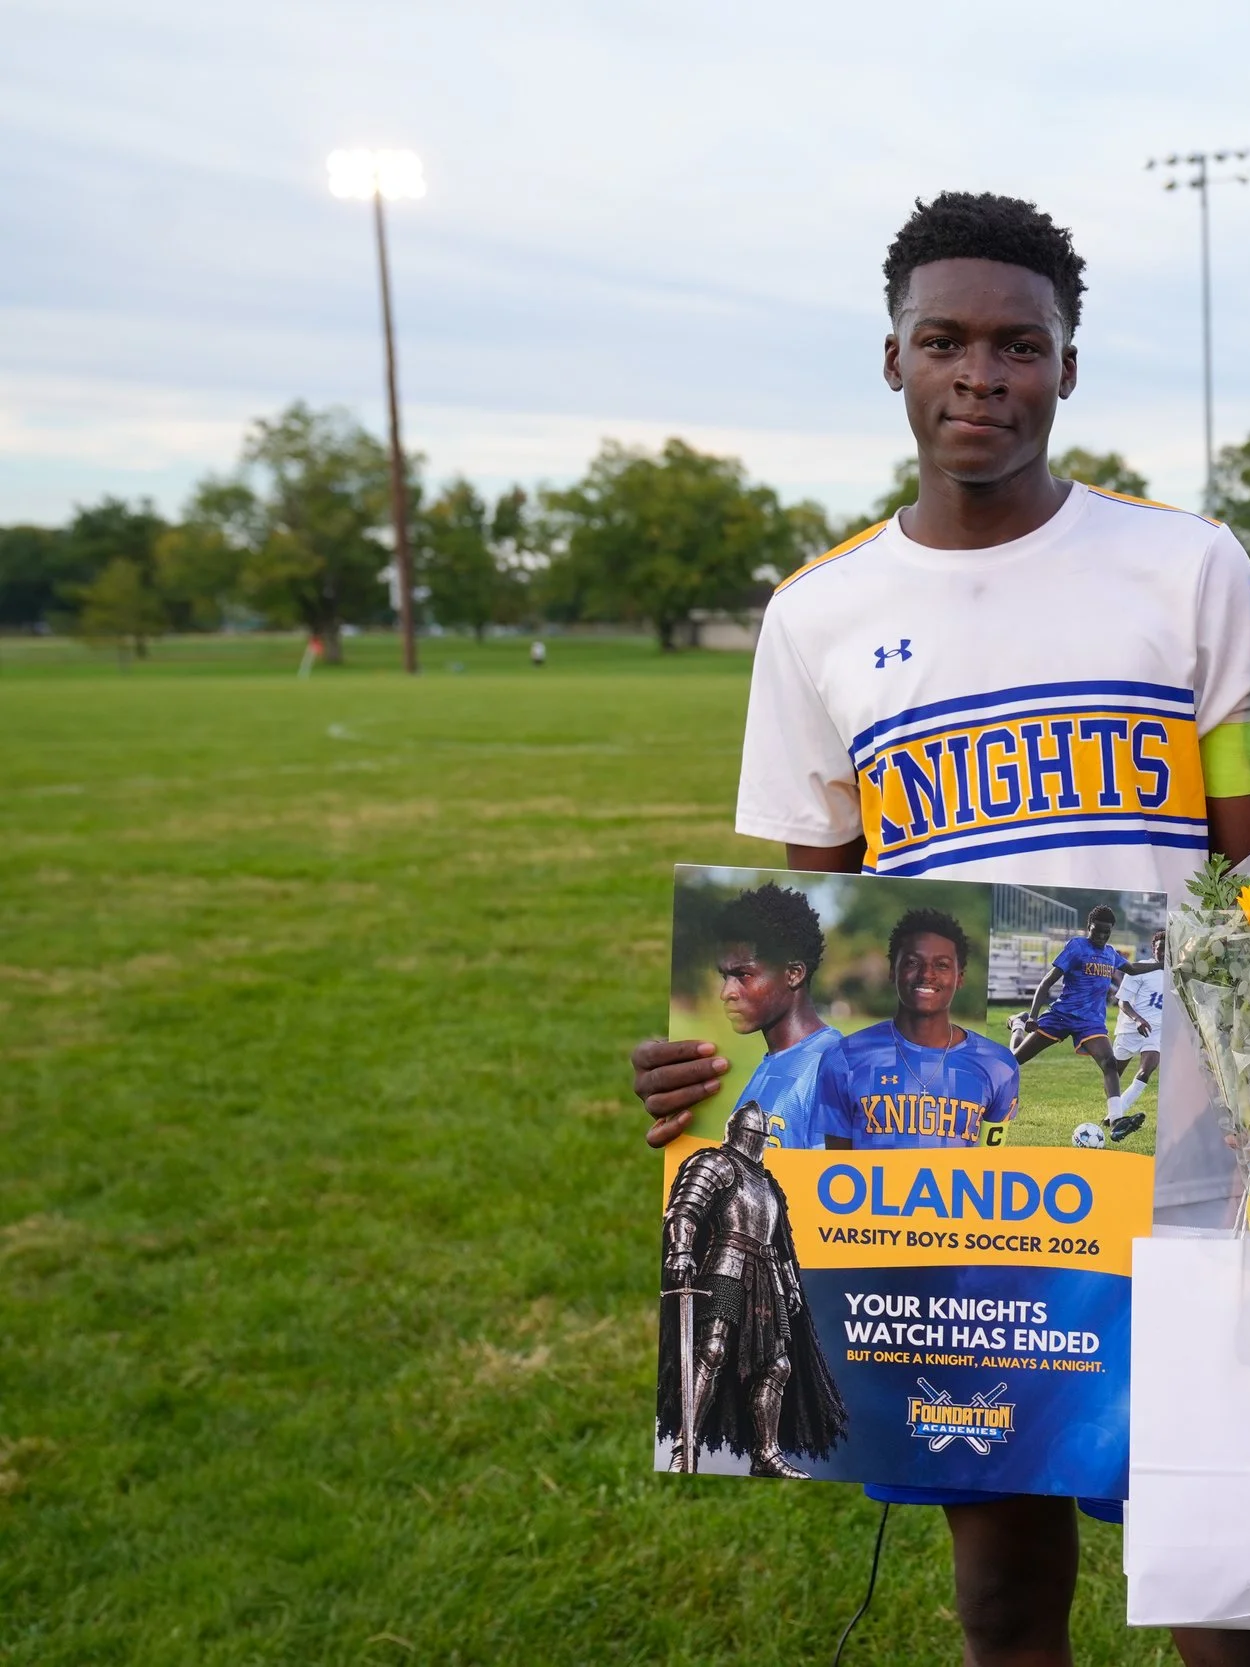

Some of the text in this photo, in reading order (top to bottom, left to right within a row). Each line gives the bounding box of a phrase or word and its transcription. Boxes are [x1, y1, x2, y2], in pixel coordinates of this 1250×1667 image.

[986, 1126, 1003, 1146] C
[817, 1163, 1093, 1224] OLANDO
[818, 1226, 1100, 1255] VARSITY BOYS SOCCER 2026
[844, 1293, 1047, 1324] YOUR KNIGHTS
[844, 1321, 1100, 1354] WATCH HAS ENDED
[847, 1350, 1106, 1373] BUT ONCE A KNIGHT, ALWAYS A KNIGHT.
[911, 1399, 1010, 1429] FOUNDATION
[922, 1424, 997, 1436] ACADEMIES
